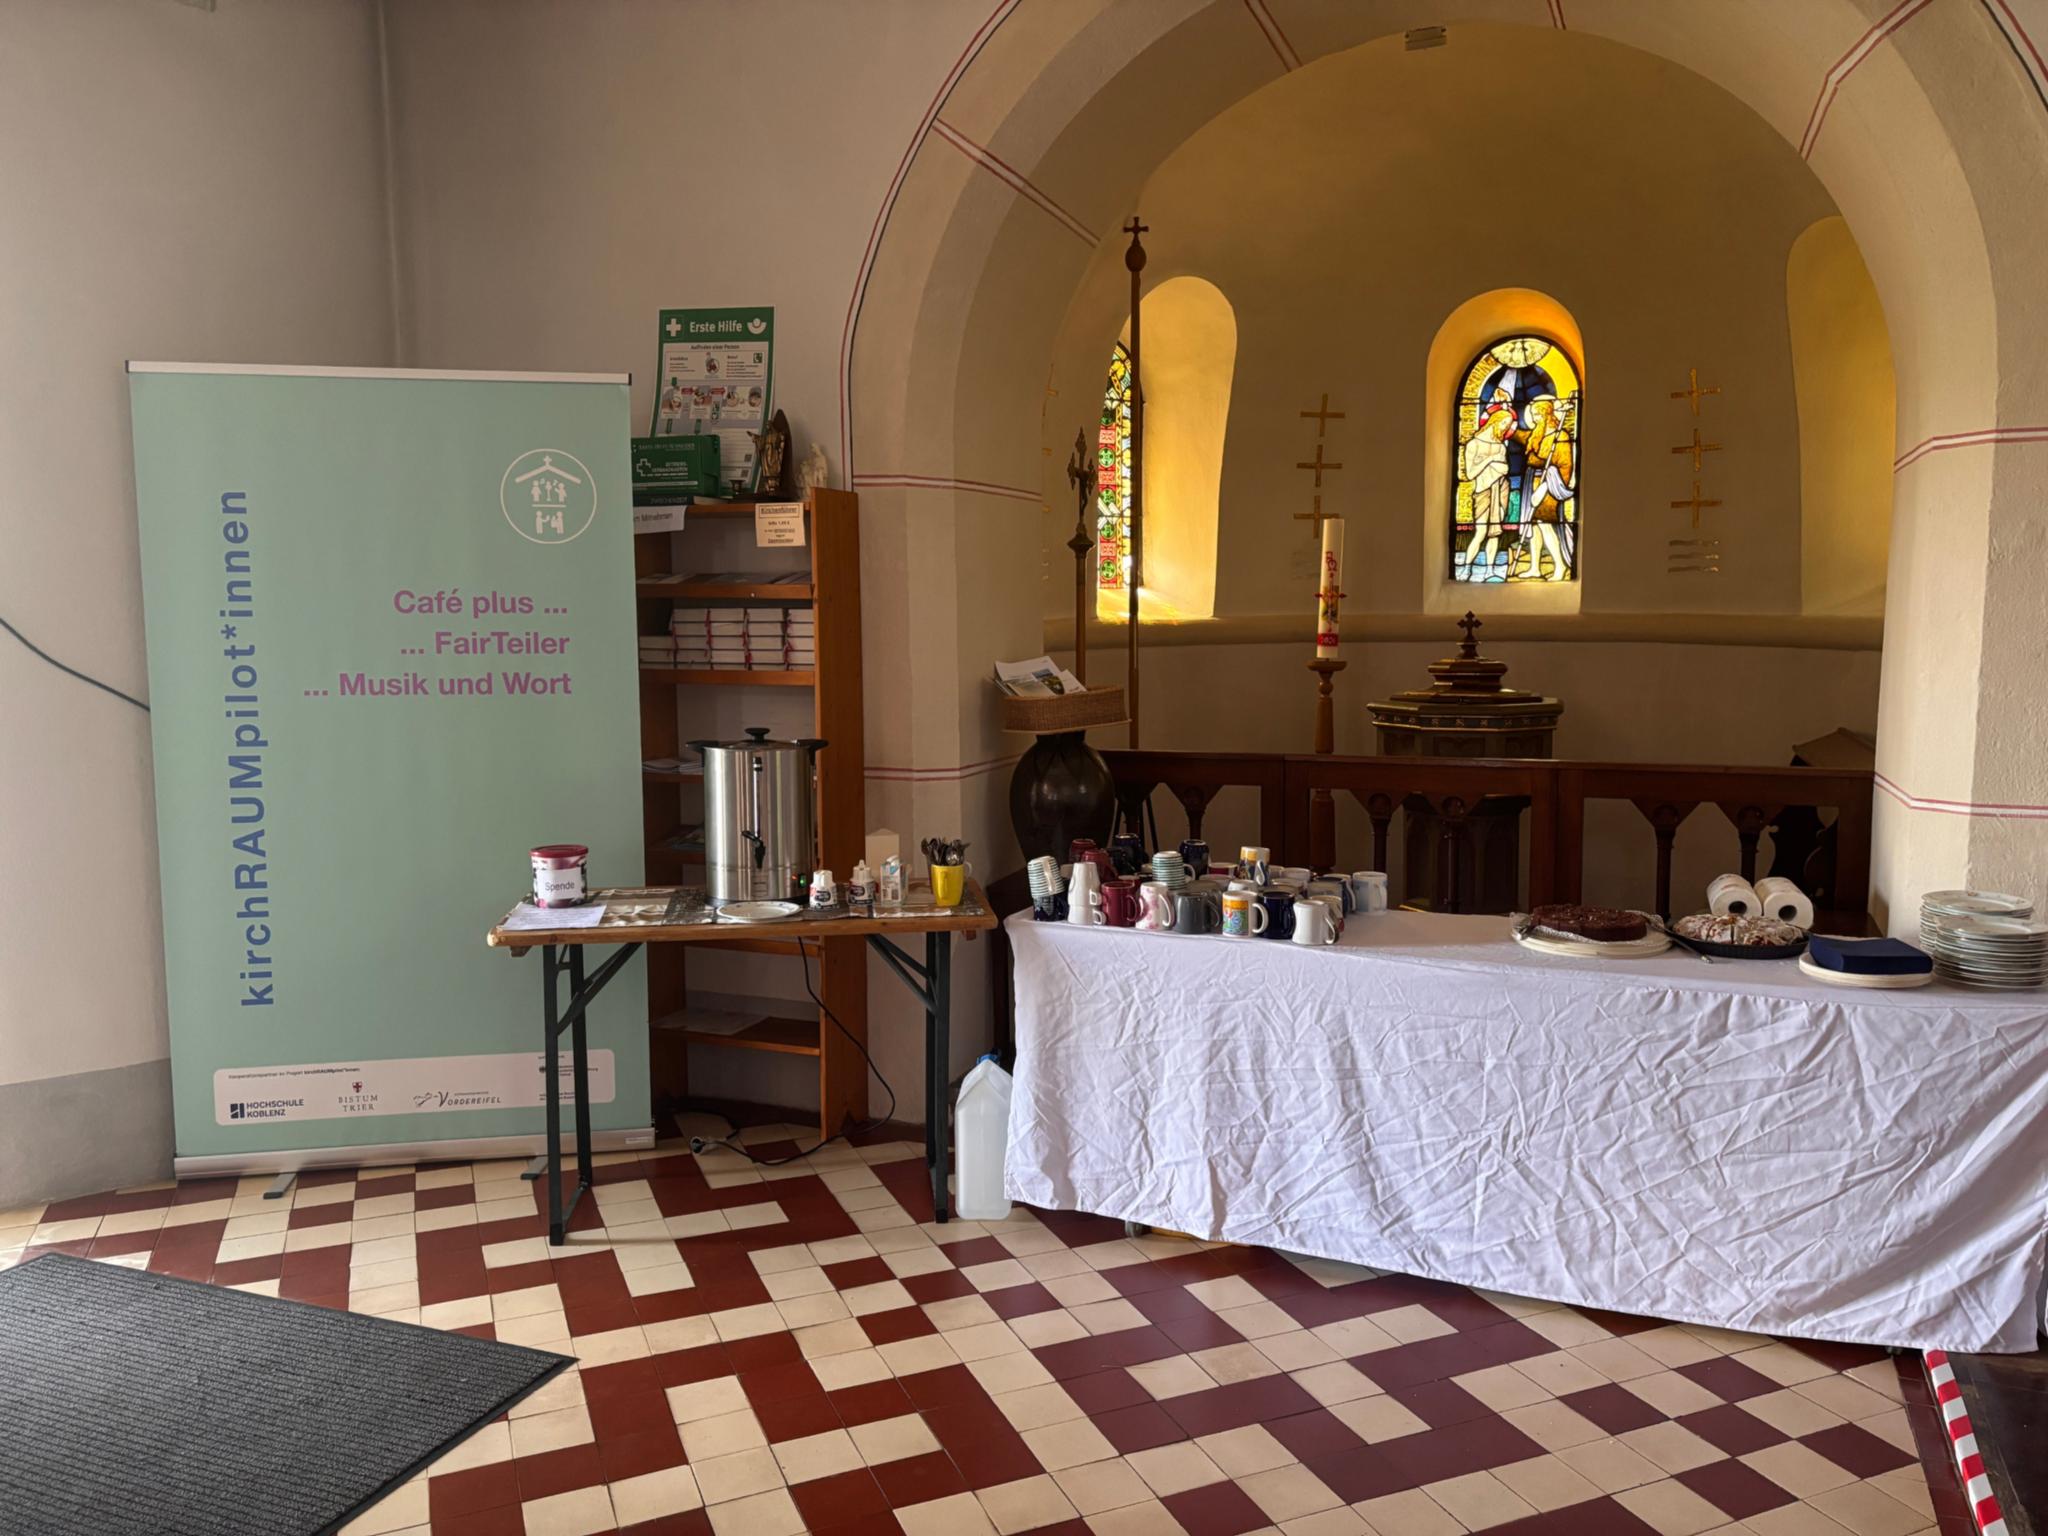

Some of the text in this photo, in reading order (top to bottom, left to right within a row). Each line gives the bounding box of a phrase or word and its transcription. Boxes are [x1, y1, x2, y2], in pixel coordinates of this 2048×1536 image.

[689, 319, 743, 333] Erste Hilfe
[393, 588, 463, 614] Café
[472, 591, 534, 618] plus
[435, 631, 570, 654] FairTeiler
[339, 672, 429, 696] Musik
[438, 672, 493, 695] und
[502, 672, 572, 695] Wort
[545, 881, 575, 891] Spende
[246, 1098, 304, 1110] HOCHSCHULE
[338, 1094, 379, 1104] BISTUM
[246, 1108, 286, 1118] KOBLENZ
[343, 1104, 375, 1113] TRIER
